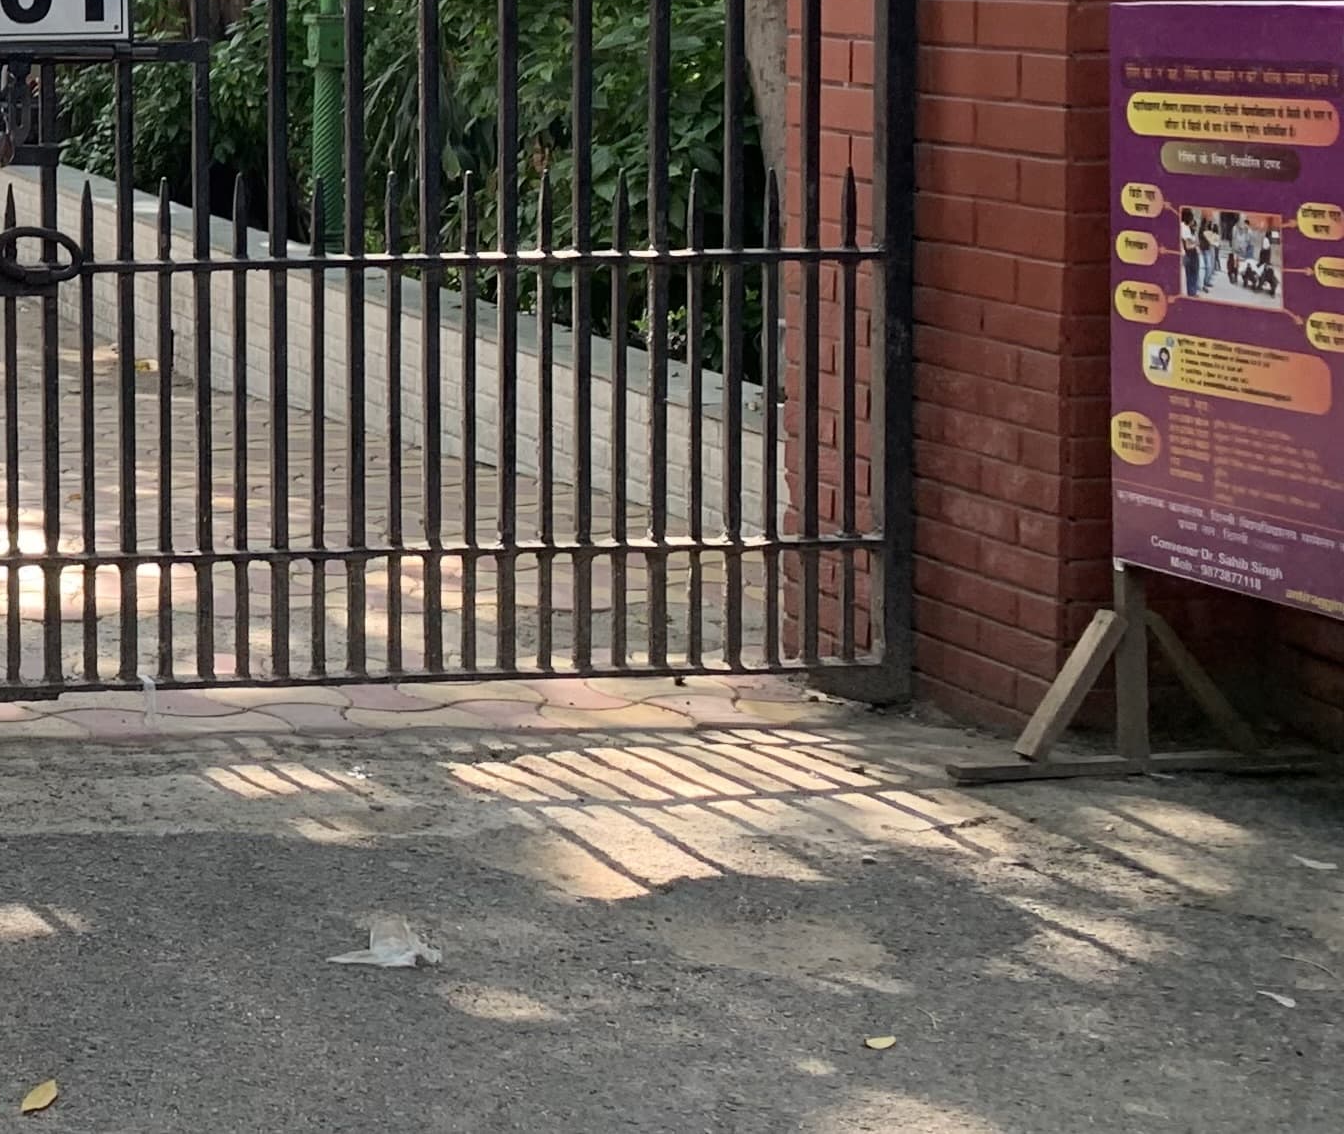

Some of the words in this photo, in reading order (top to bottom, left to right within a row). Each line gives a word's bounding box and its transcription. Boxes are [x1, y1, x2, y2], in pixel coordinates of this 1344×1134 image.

[1150, 535, 1200, 559] Convener
[1201, 547, 1216, 562] Dr.
[1218, 552, 1249, 572] Sahib
[1251, 561, 1284, 581] Singh
